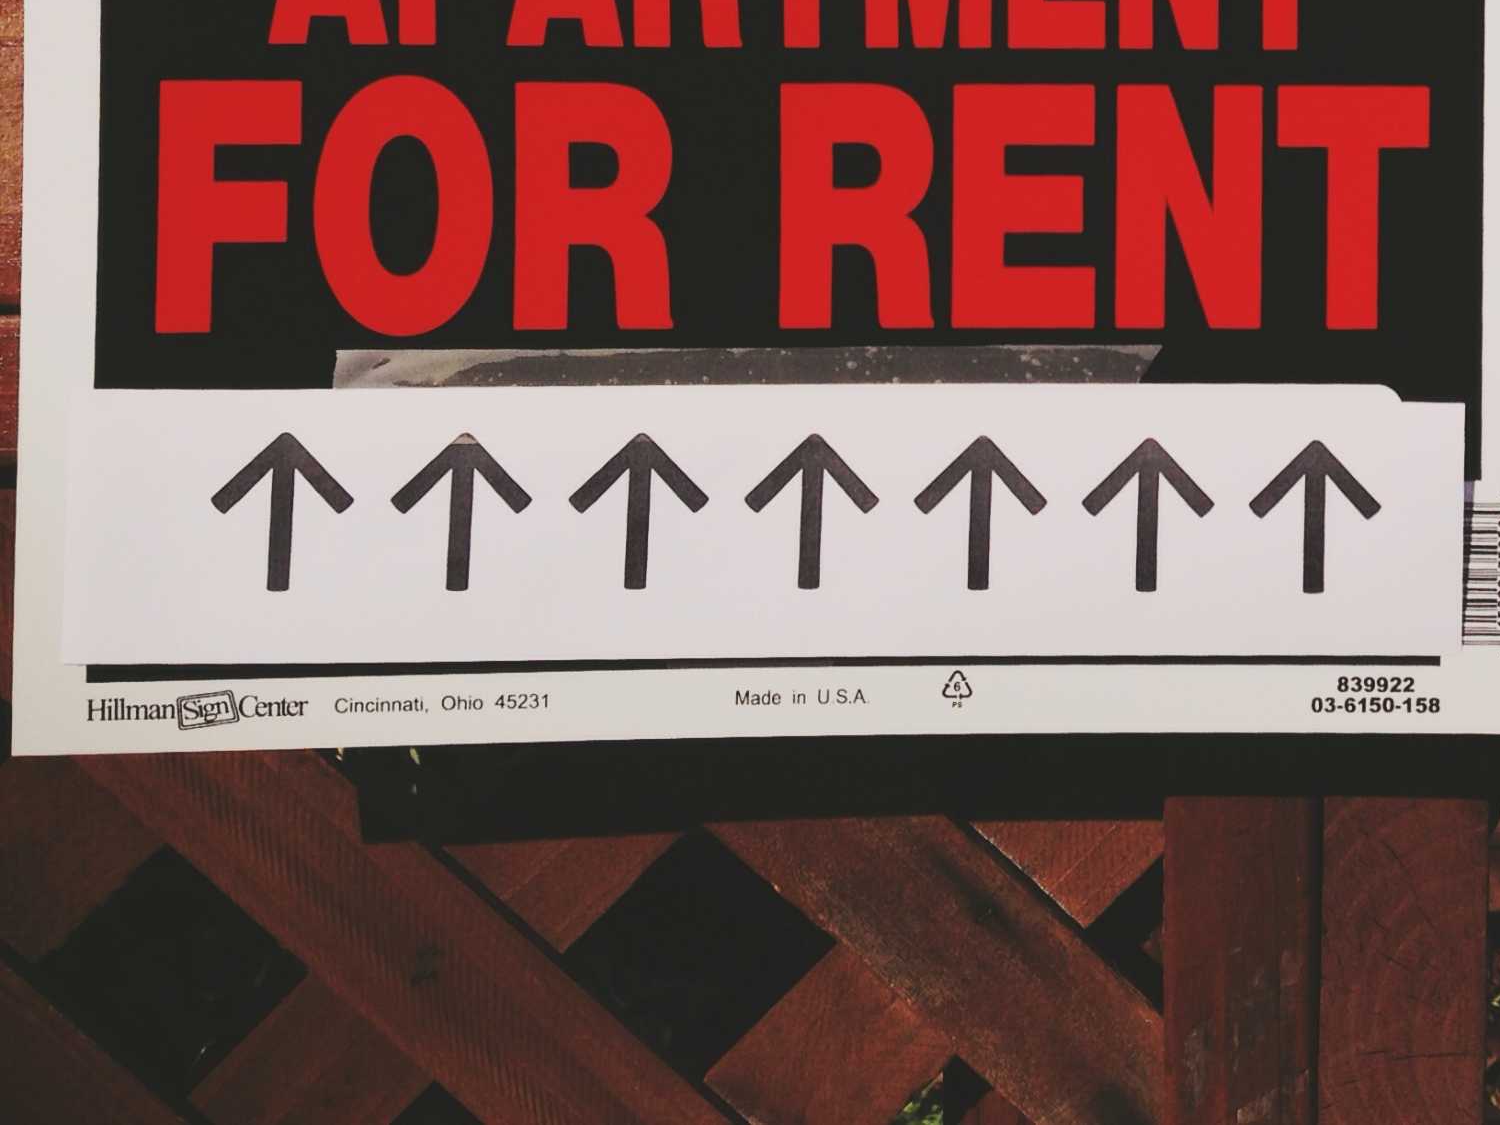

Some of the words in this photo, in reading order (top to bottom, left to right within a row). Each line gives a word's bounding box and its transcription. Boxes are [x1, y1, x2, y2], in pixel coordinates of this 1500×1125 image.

[155, 75, 674, 336] FOR
[779, 83, 1431, 330] RENT
[1337, 676, 1415, 693] 839922
[334, 697, 429, 714] Cincinnati,
[441, 695, 484, 711] Ohio
[494, 693, 550, 710] 45231
[735, 690, 782, 706] Made
[792, 689, 806, 705] in
[1311, 697, 1440, 713] 03-6150-158
[86, 697, 175, 722] Hillman
[183, 699, 229, 723] Sign
[239, 695, 309, 718] Center
